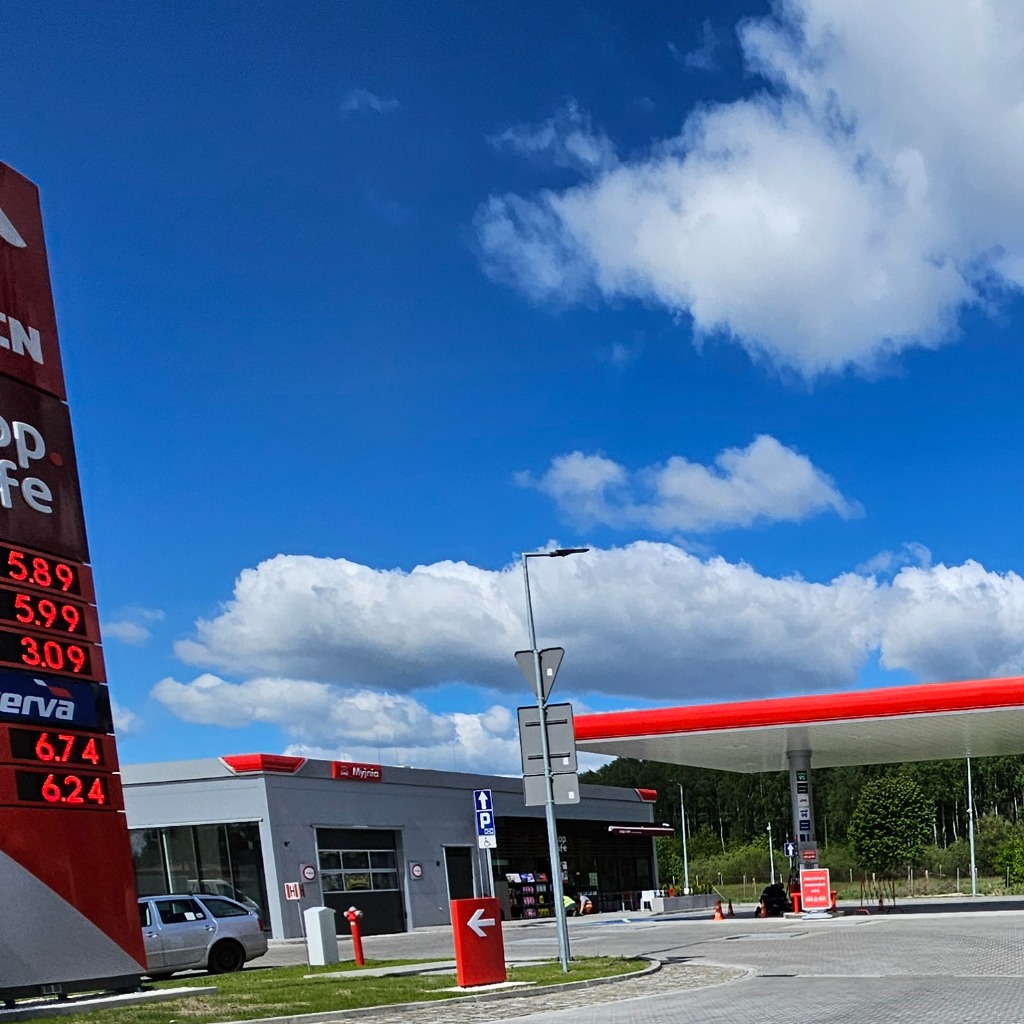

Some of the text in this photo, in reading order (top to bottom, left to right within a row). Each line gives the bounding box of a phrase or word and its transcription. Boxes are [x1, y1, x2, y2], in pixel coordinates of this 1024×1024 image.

[8, 551, 74, 591] 5.89
[15, 594, 80, 633] 5.99
[21, 637, 85, 672] 3.09
[0, 691, 75, 720] erva
[36, 733, 100, 764] 6.74
[353, 767, 379, 778] Myjnia
[42, 774, 105, 804] 6.24
[480, 813, 491, 829] P
